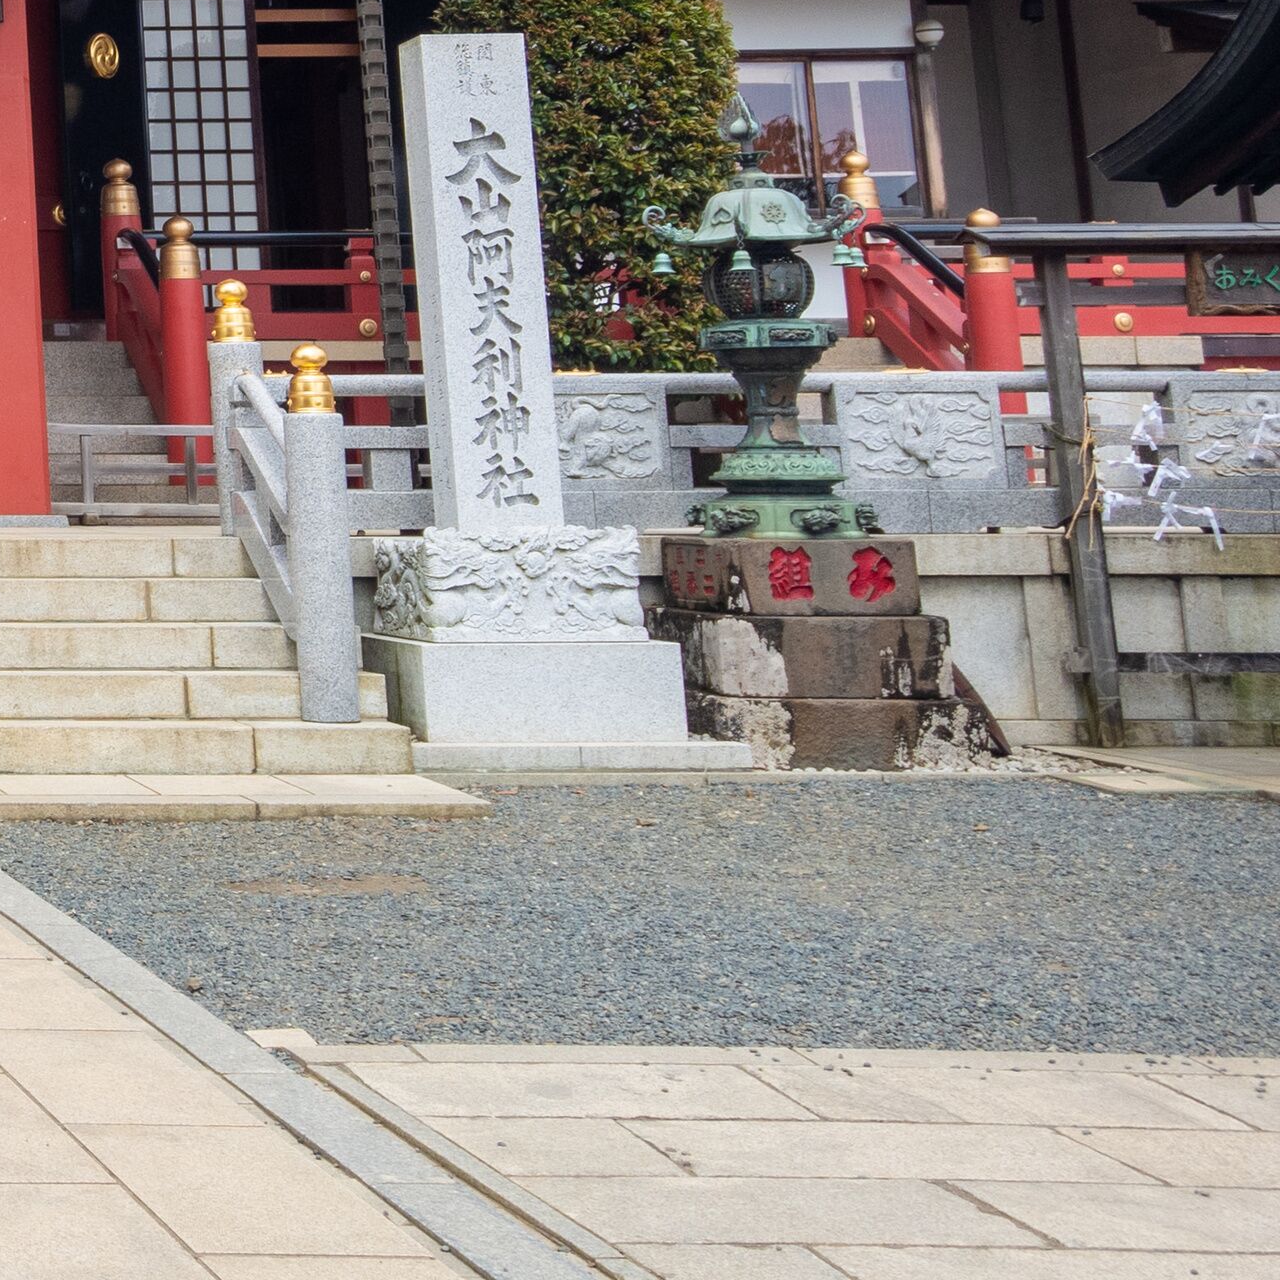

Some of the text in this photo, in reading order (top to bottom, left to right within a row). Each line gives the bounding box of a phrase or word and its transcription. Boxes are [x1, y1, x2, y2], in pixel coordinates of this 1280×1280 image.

[445, 117, 539, 508] 大山阿夫利神社
